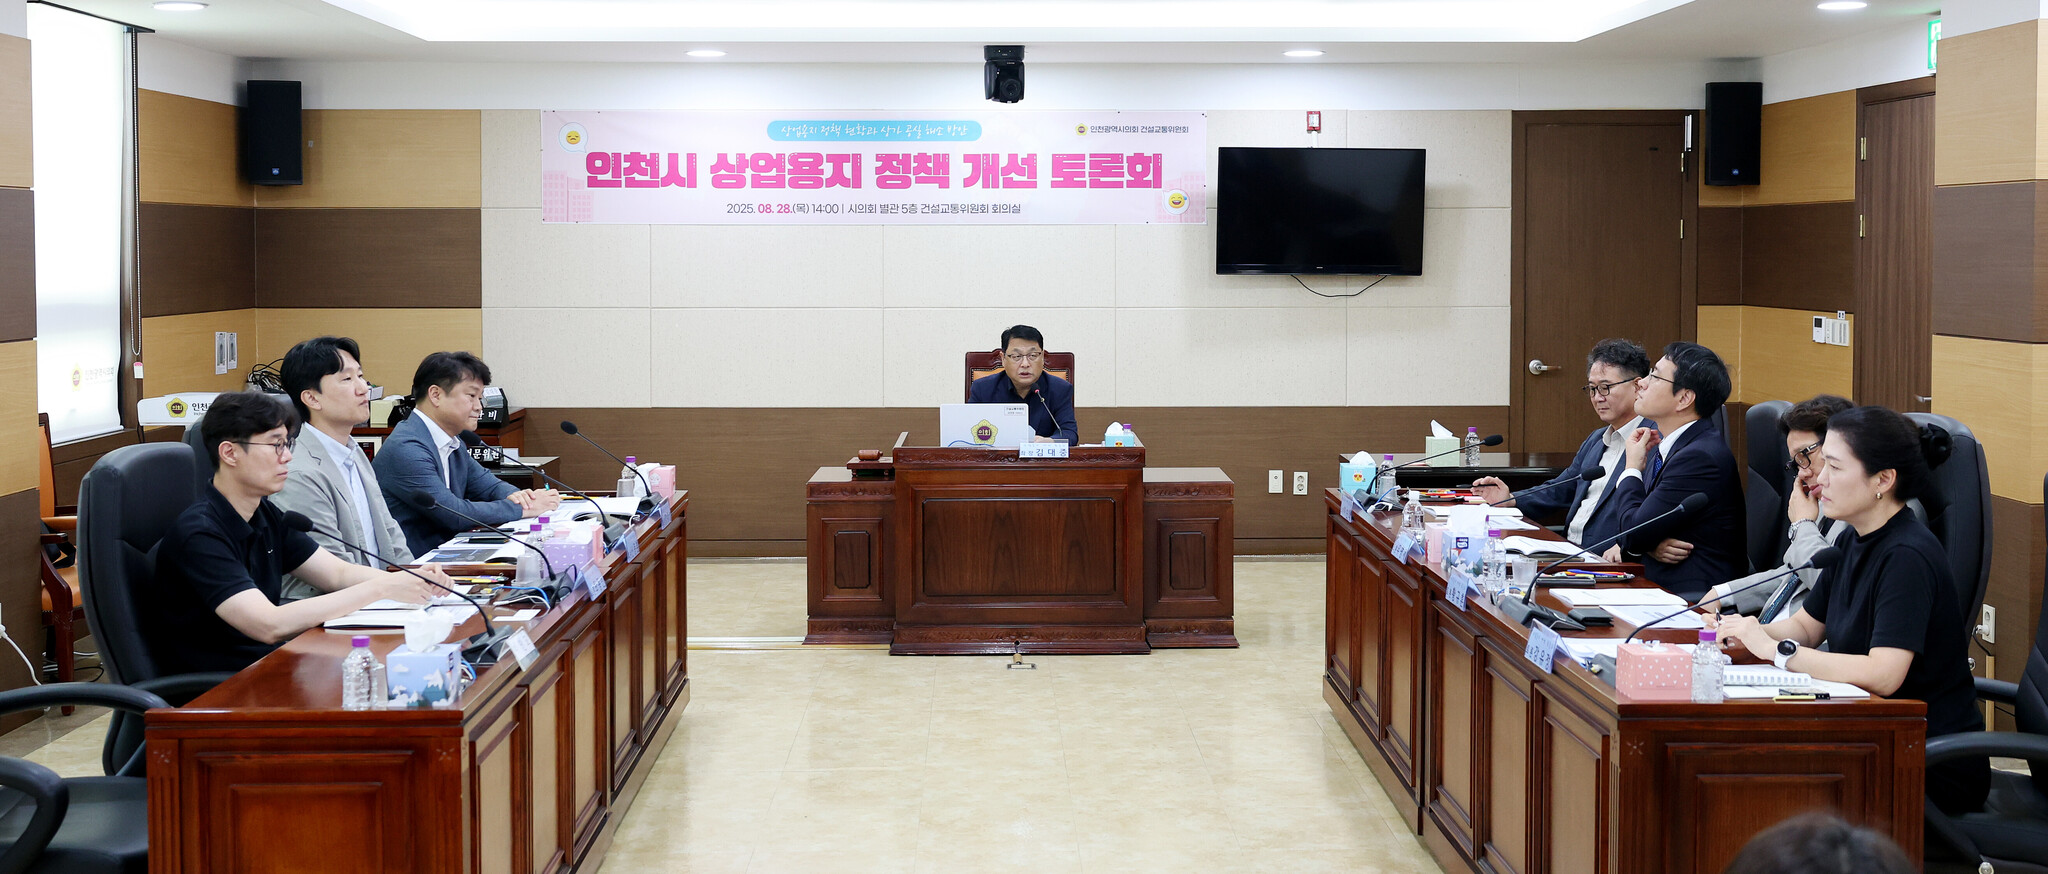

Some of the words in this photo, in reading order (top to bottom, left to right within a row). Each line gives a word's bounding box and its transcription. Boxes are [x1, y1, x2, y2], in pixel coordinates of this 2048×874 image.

[781, 124, 817, 138] 상업용지
[820, 123, 842, 137] 정책
[845, 124, 878, 136] 현황과
[880, 125, 901, 137] 상가
[905, 125, 922, 139] 공실
[925, 125, 943, 136] 해소
[947, 125, 967, 136] 방안
[1090, 125, 1139, 133] 인천광역시의회
[1140, 125, 1189, 133] 건설교통위원회
[586, 152, 697, 189] 인천시
[710, 152, 862, 189] 상업용지
[875, 152, 950, 189] 정책
[963, 153, 1037, 189] 개선
[1051, 153, 1163, 189] 토론회
[726, 203, 756, 214] 2025.
[757, 203, 774, 214] 08.
[811, 203, 839, 214] 14:00
[847, 203, 877, 214] 시의회
[879, 203, 899, 214] 별관
[901, 203, 918, 214] 5층
[920, 203, 989, 214] 건설교통위원회
[991, 203, 1021, 214] 회의실
